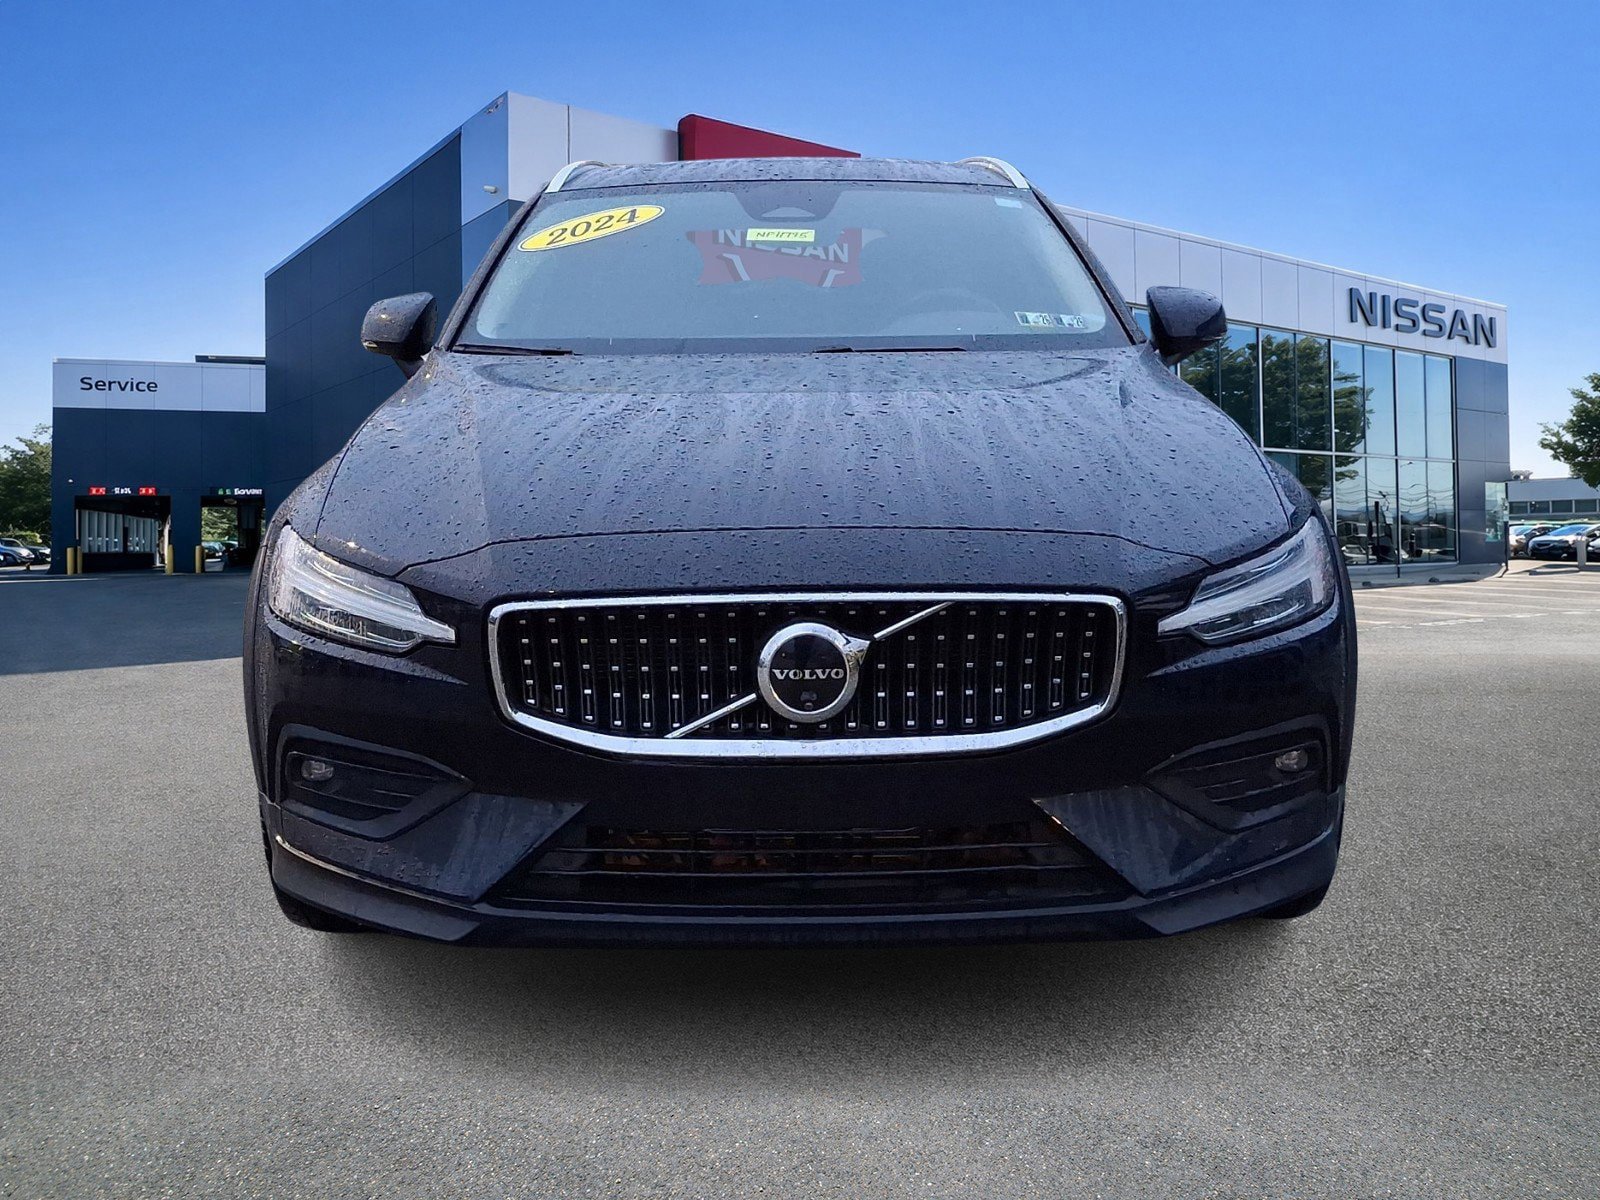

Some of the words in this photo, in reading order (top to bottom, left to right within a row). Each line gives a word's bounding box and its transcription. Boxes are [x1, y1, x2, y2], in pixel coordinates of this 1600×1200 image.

[546, 208, 639, 246] 2024
[1348, 287, 1497, 348] NISSAN
[80, 376, 158, 393] Service
[771, 668, 845, 680] VOLVO
